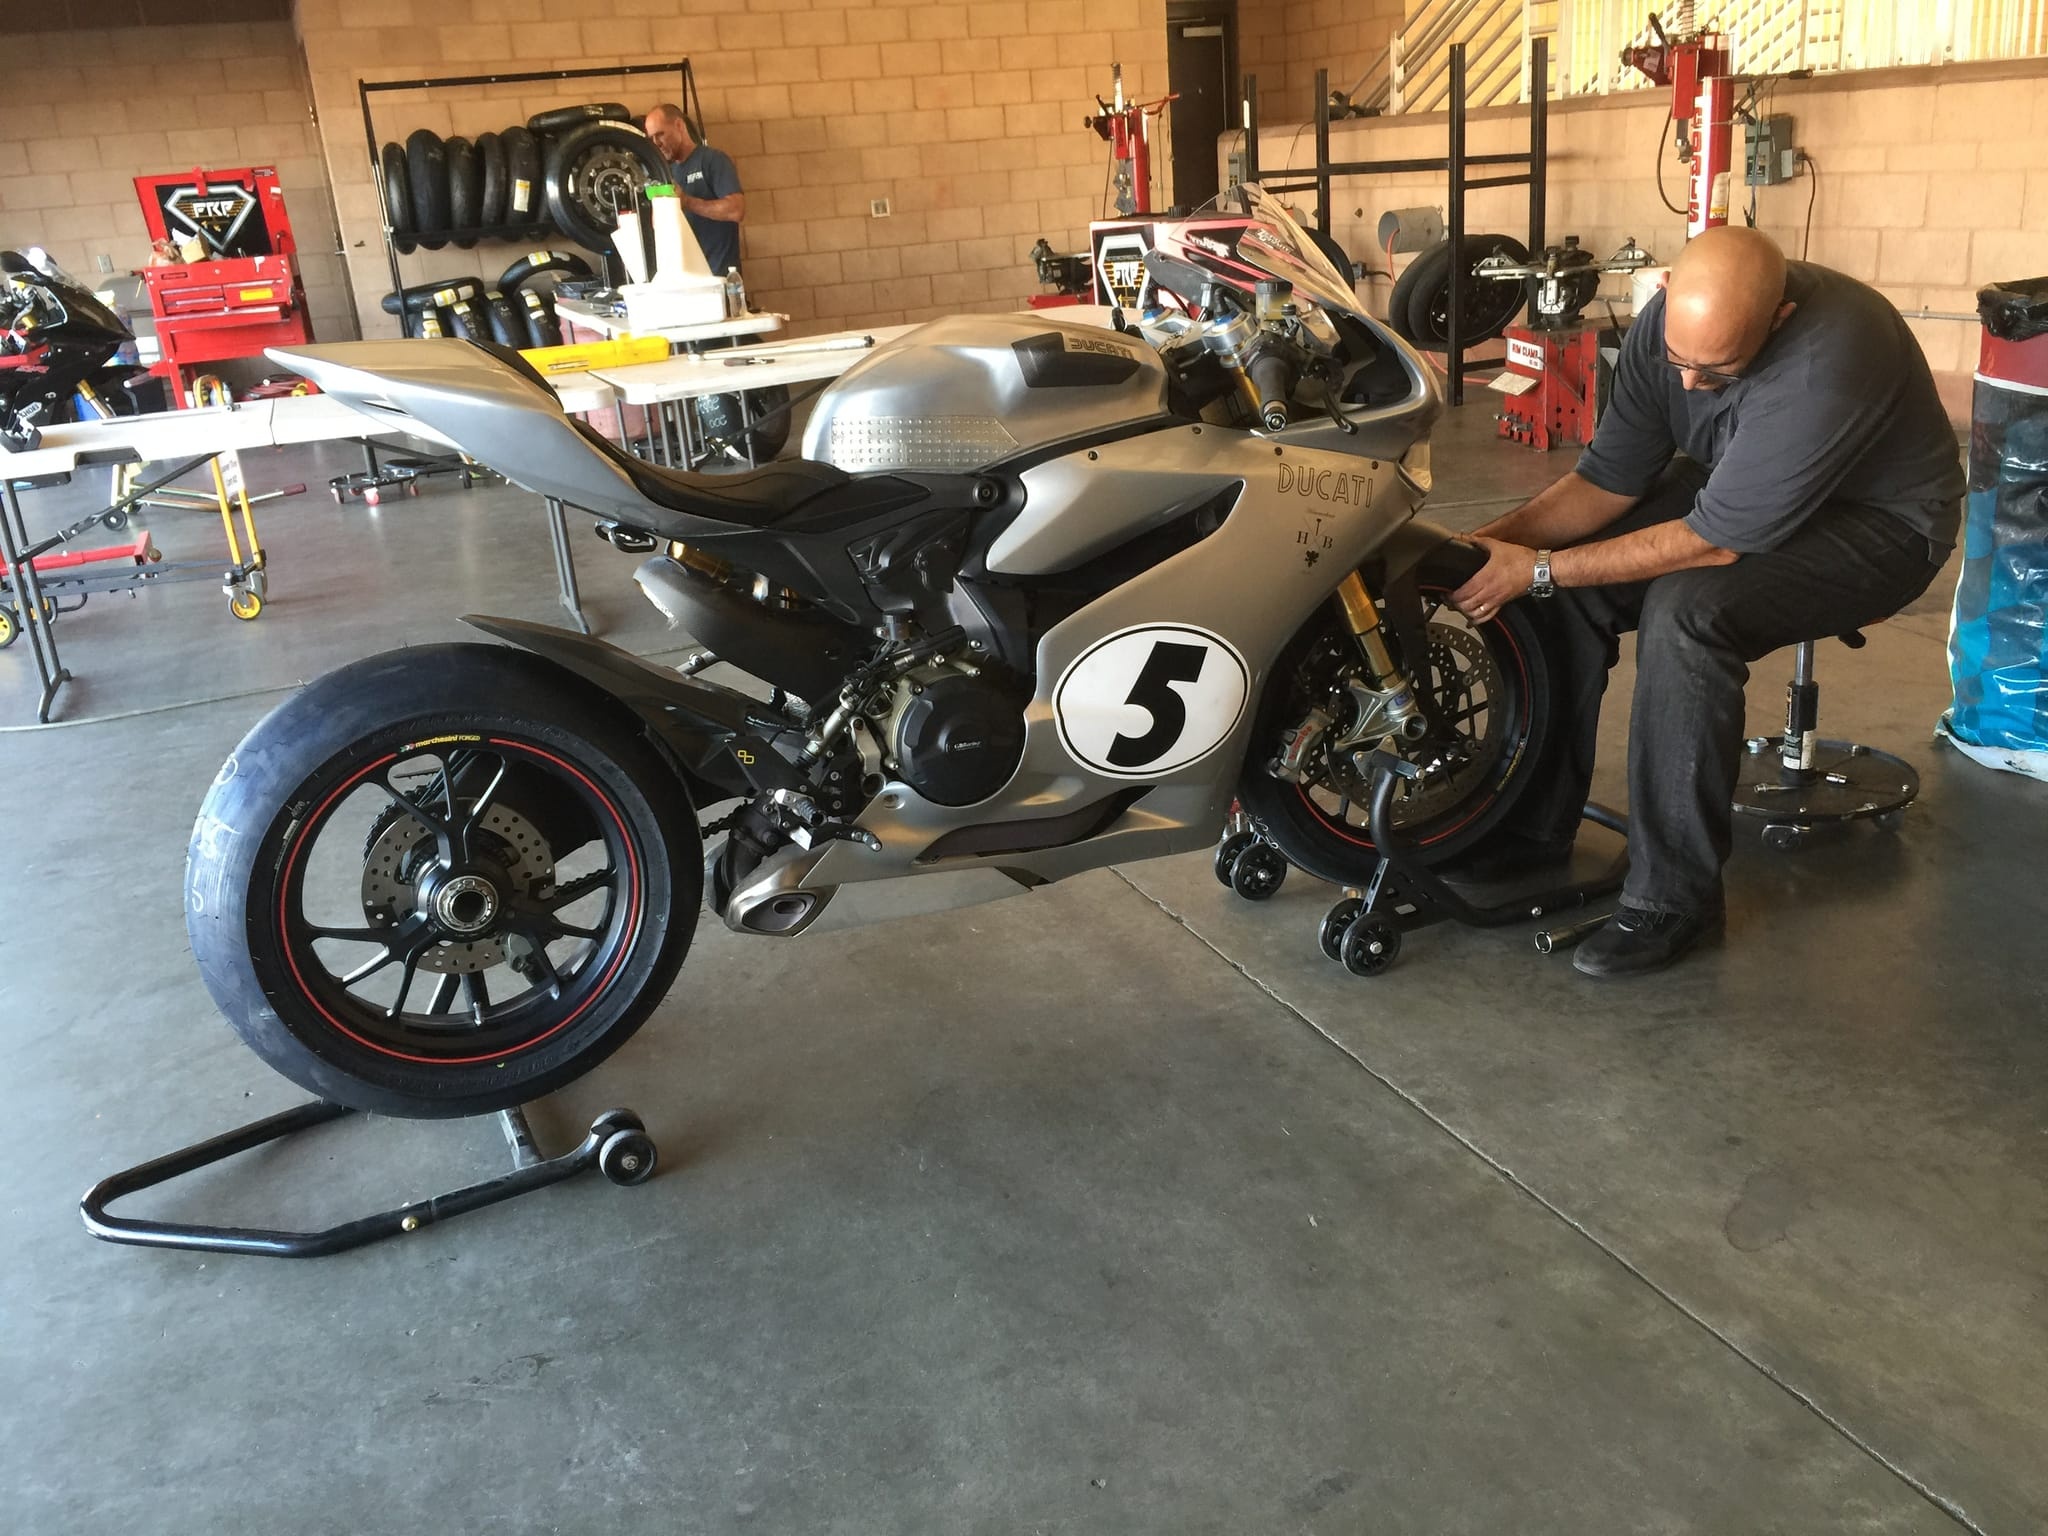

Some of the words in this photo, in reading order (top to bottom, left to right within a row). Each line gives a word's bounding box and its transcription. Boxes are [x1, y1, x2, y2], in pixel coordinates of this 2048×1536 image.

[1068, 337, 1135, 360] DUCATI
[1278, 462, 1374, 509] DUCATI
[1296, 531, 1309, 545] H
[1323, 536, 1334, 549] B
[1105, 640, 1208, 768] 5
